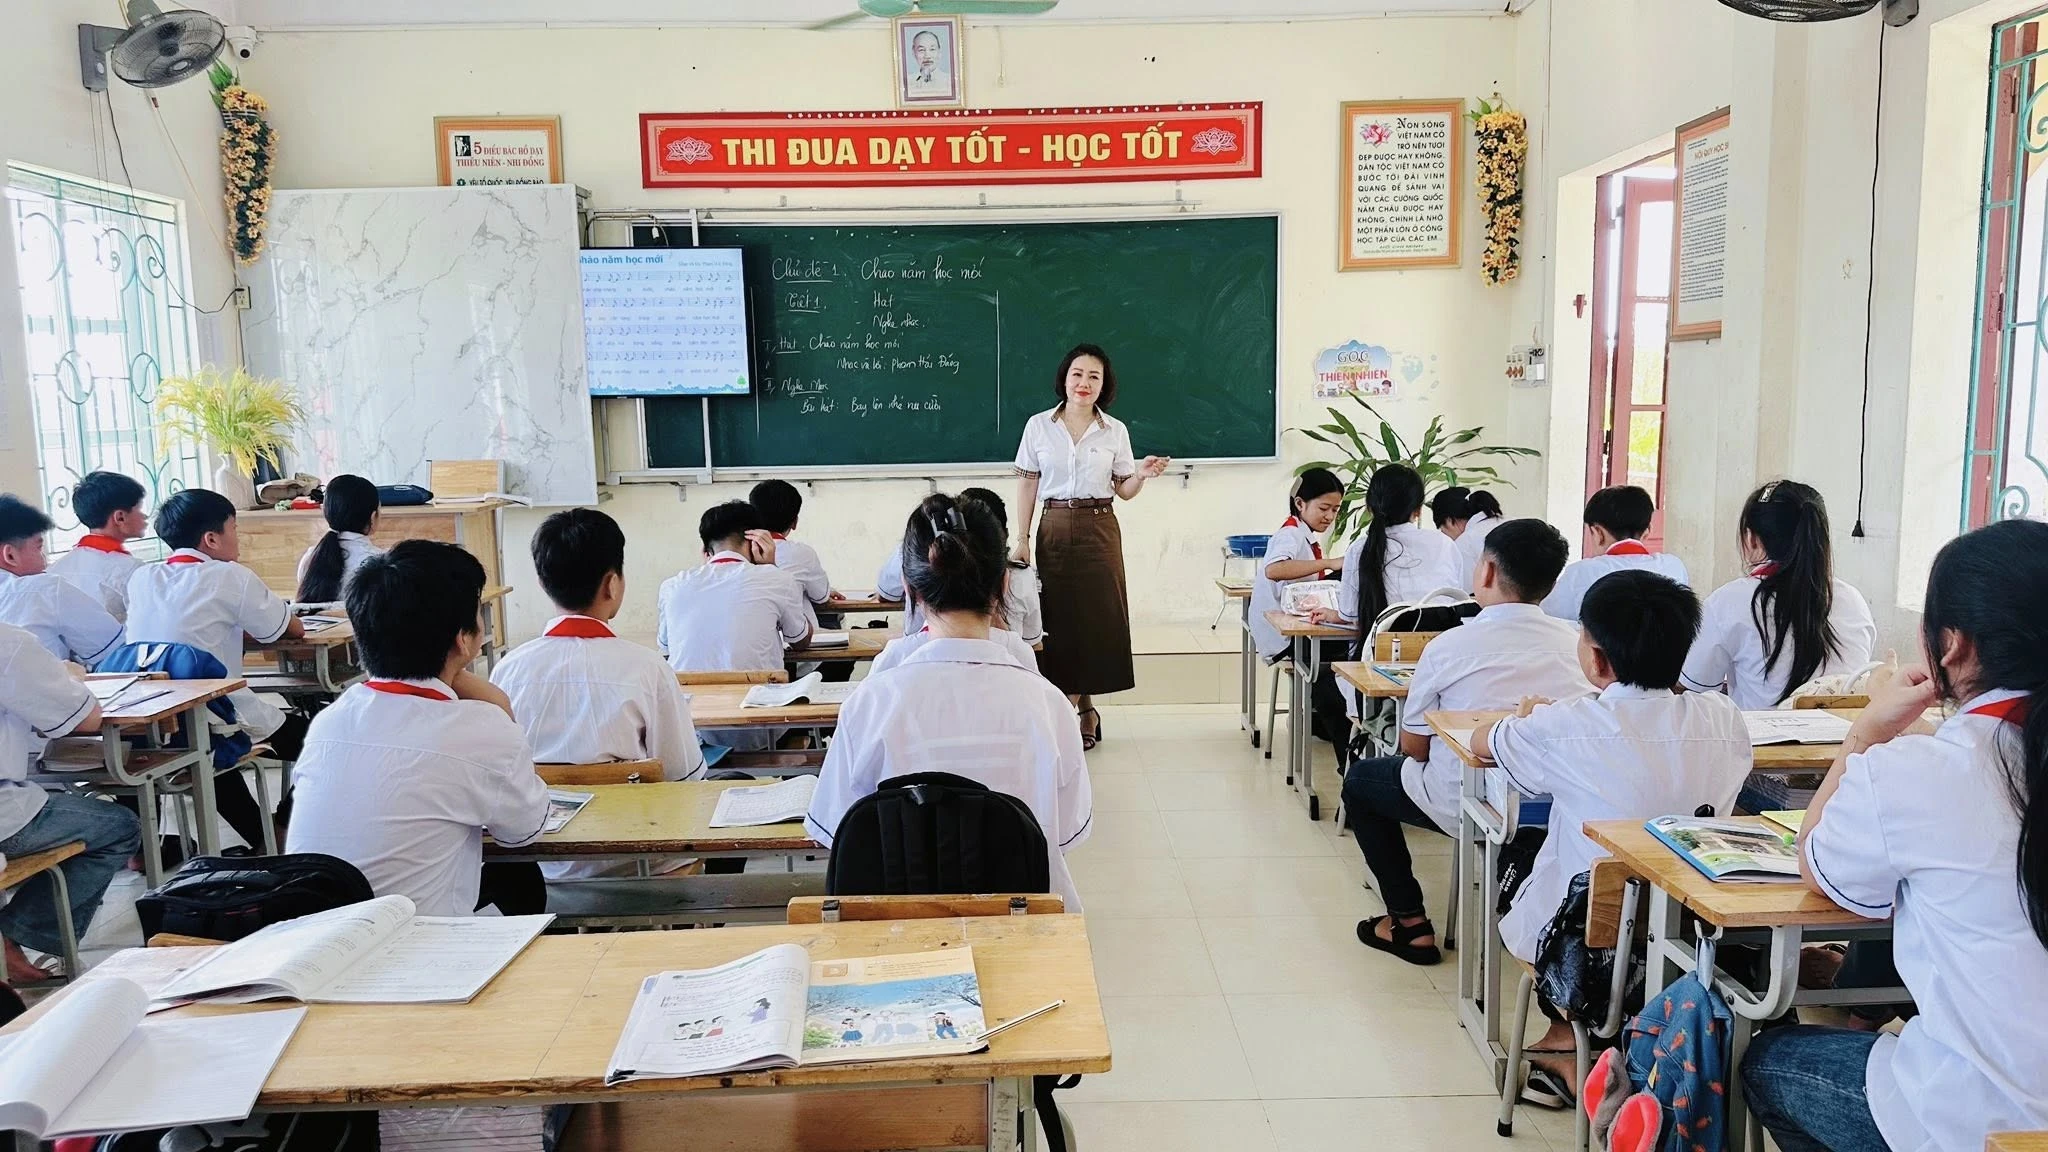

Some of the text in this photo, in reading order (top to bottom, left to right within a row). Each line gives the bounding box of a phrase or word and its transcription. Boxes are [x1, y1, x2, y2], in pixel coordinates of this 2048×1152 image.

[1396, 117, 1445, 129] NON SÔNG
[1397, 130, 1445, 140] VIỆT NAM CÓ
[474, 141, 482, 155] 5
[502, 144, 518, 155] BÁC
[518, 144, 529, 155] HỒ
[530, 146, 544, 157] DẠY
[721, 138, 776, 166] THI
[787, 137, 858, 166] ĐUA
[868, 136, 936, 171] DẠY
[946, 126, 1007, 164] TỐT
[1042, 133, 1111, 168] HỌC
[1121, 121, 1183, 160] TỐT
[507, 158, 521, 167] NHI
[1432, 161, 1445, 169] CÓ
[1424, 172, 1445, 180] VINH
[1358, 184, 1387, 193] QUANG
[1422, 192, 1444, 201] QUỐC
[1420, 224, 1443, 232] CÔNG
[1356, 236, 1373, 244] HỌC
[601, 254, 623, 265] năm
[625, 254, 643, 266] học
[645, 253, 664, 264] mới
[861, 256, 895, 280] Chào
[901, 260, 926, 279] năm
[932, 254, 953, 282] học
